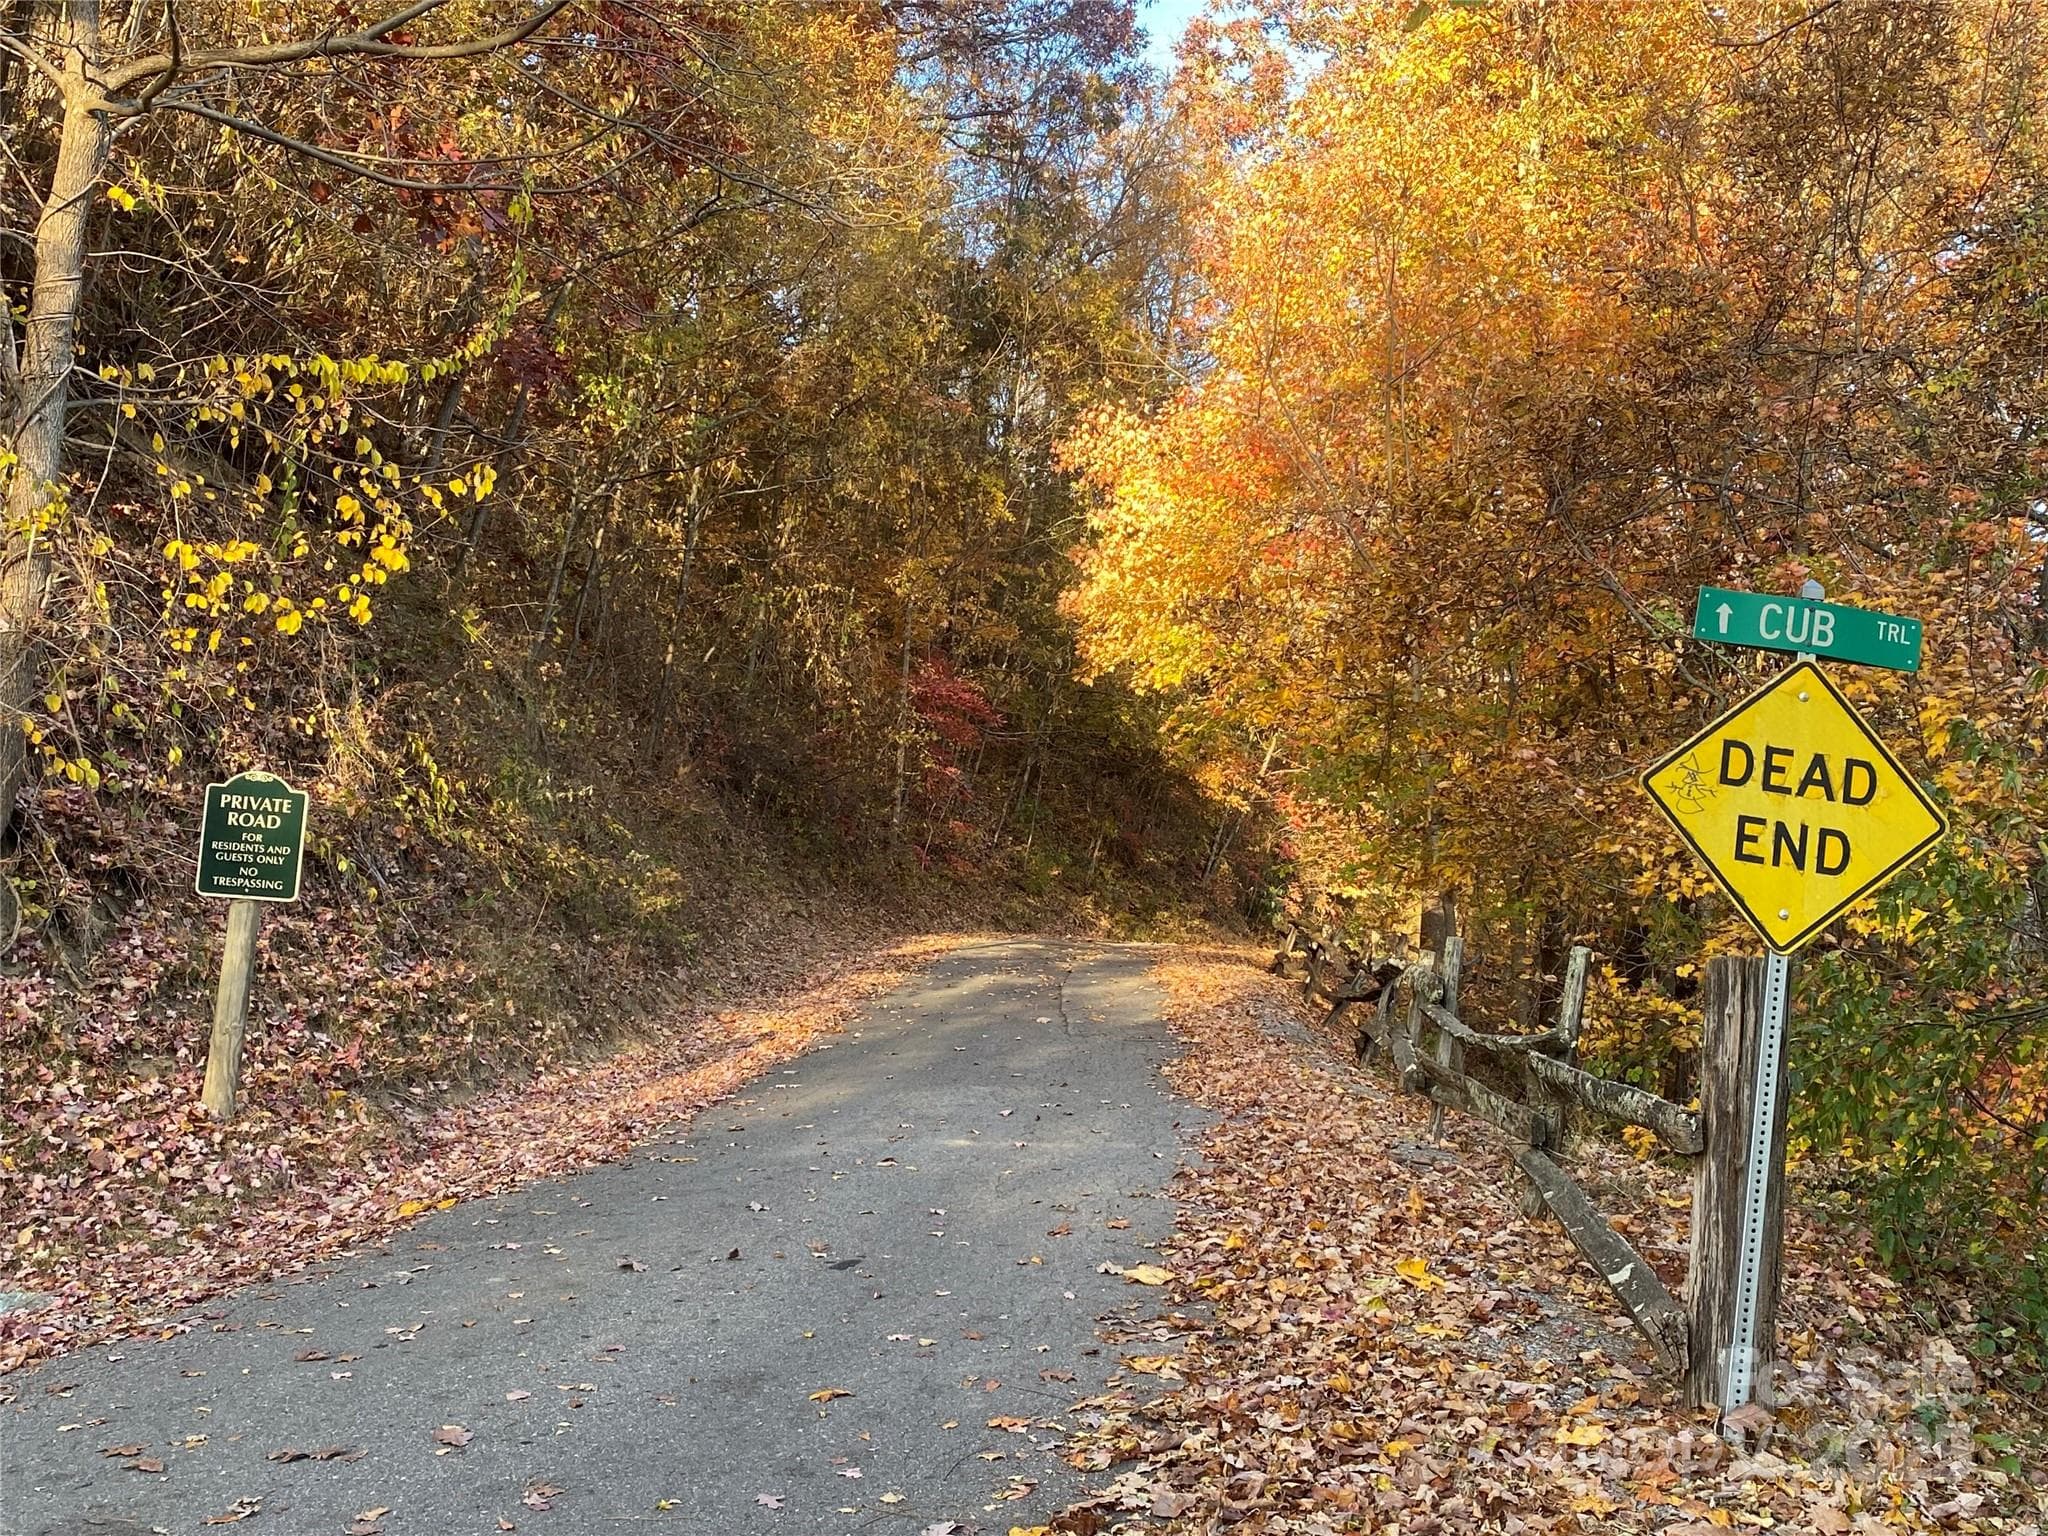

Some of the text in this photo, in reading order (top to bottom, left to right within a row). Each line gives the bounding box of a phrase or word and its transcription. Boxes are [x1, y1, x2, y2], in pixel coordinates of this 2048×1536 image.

[1758, 603, 1911, 648] CUB TRL
[1718, 739, 1878, 807] DEAD
[220, 794, 292, 813] PRIVATE
[228, 812, 281, 829] ROAD
[242, 833, 263, 842] FOR
[212, 841, 291, 855] RESIDENTS AND
[1733, 815, 1851, 877] END
[215, 852, 285, 865] GUESTS ONLY
[239, 867, 258, 877] NO
[213, 877, 283, 890] TRESPASSING
